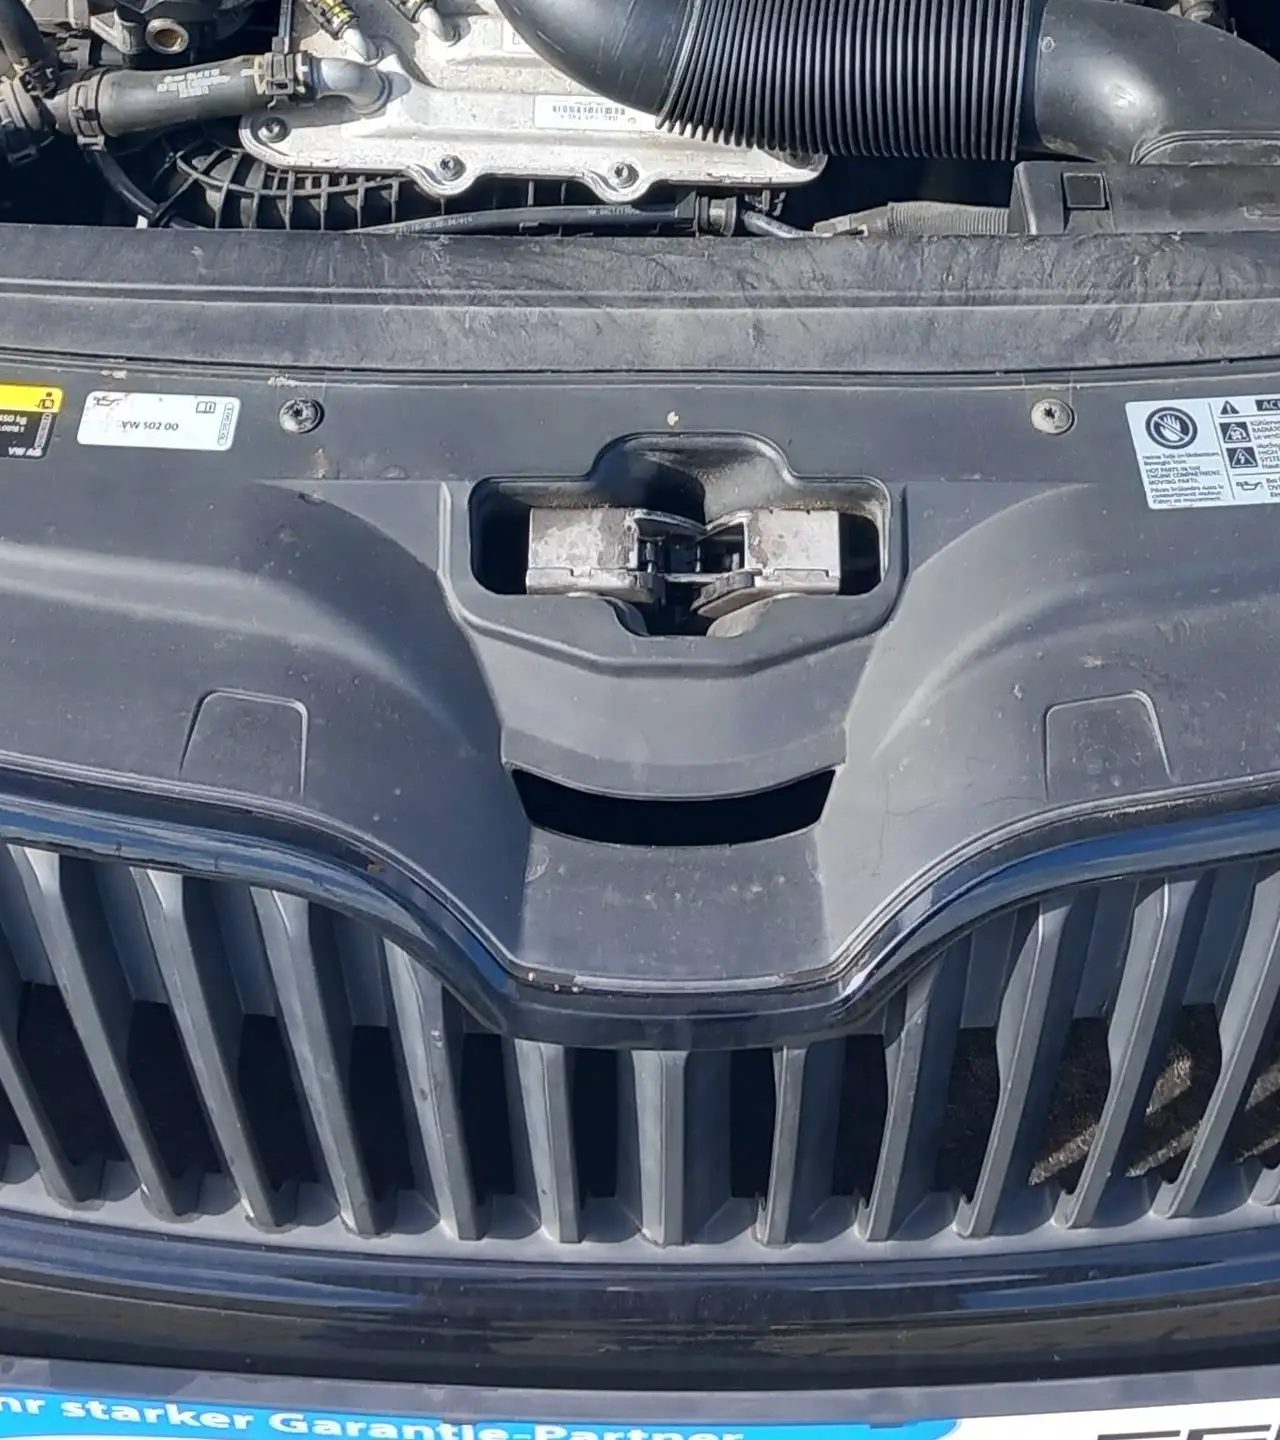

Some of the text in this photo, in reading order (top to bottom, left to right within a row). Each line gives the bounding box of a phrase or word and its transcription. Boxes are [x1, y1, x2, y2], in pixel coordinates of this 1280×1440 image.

[120, 420, 179, 431] VW 502 00
[61, 1400, 254, 1433] starker
